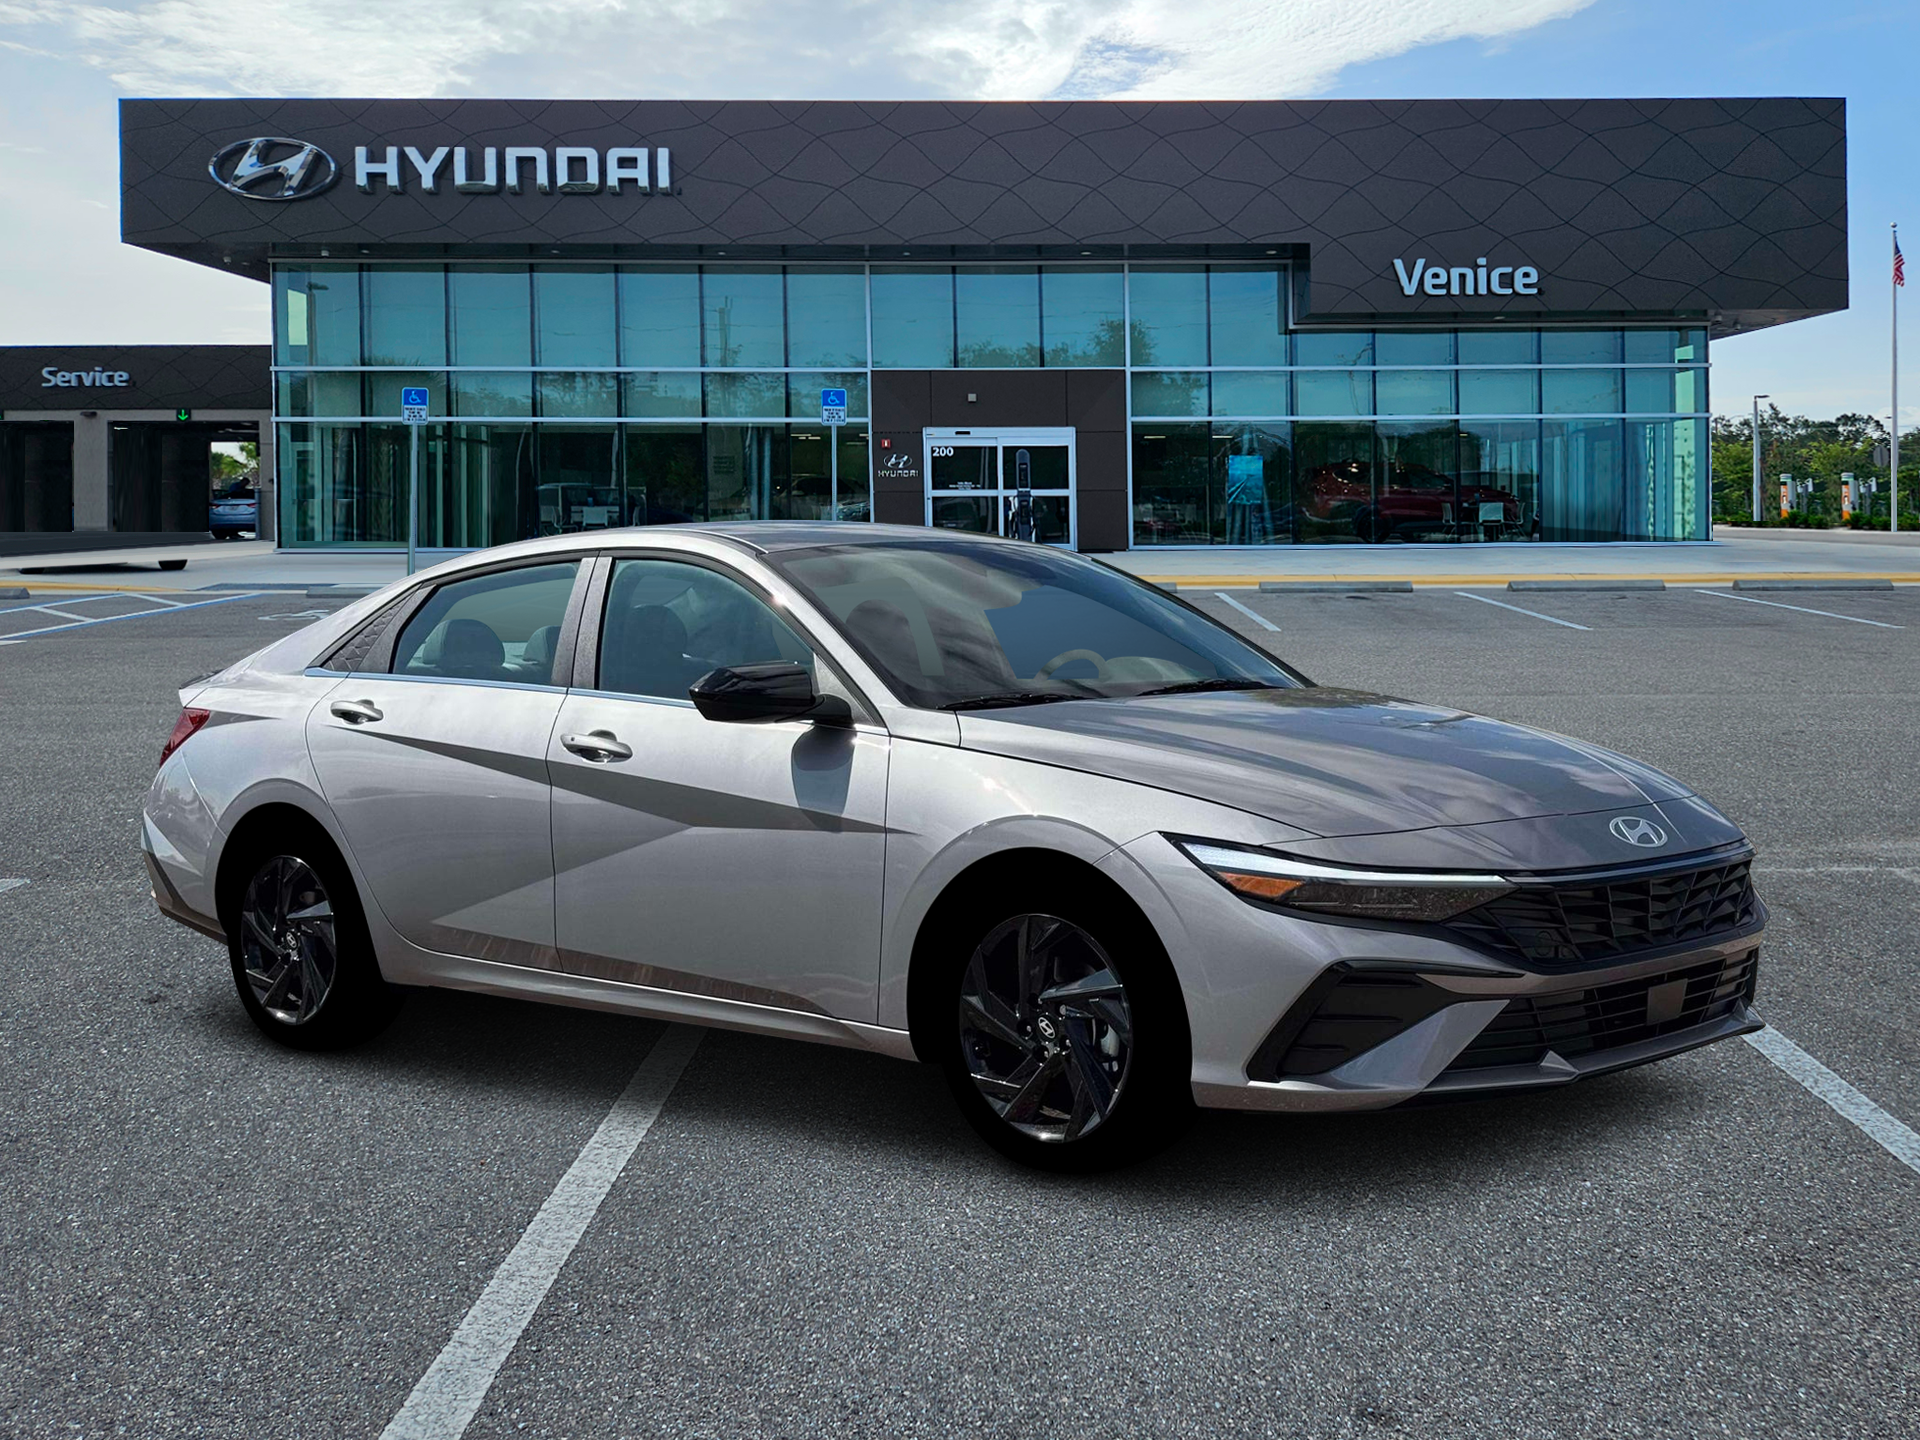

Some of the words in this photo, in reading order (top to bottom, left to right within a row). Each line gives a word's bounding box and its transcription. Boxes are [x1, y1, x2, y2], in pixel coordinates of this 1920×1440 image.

[355, 146, 670, 193] HYUNDAI
[1393, 257, 1539, 296] Venice
[41, 366, 130, 387] Service
[932, 446, 954, 457] 200
[877, 469, 919, 478] HYUNDAI
